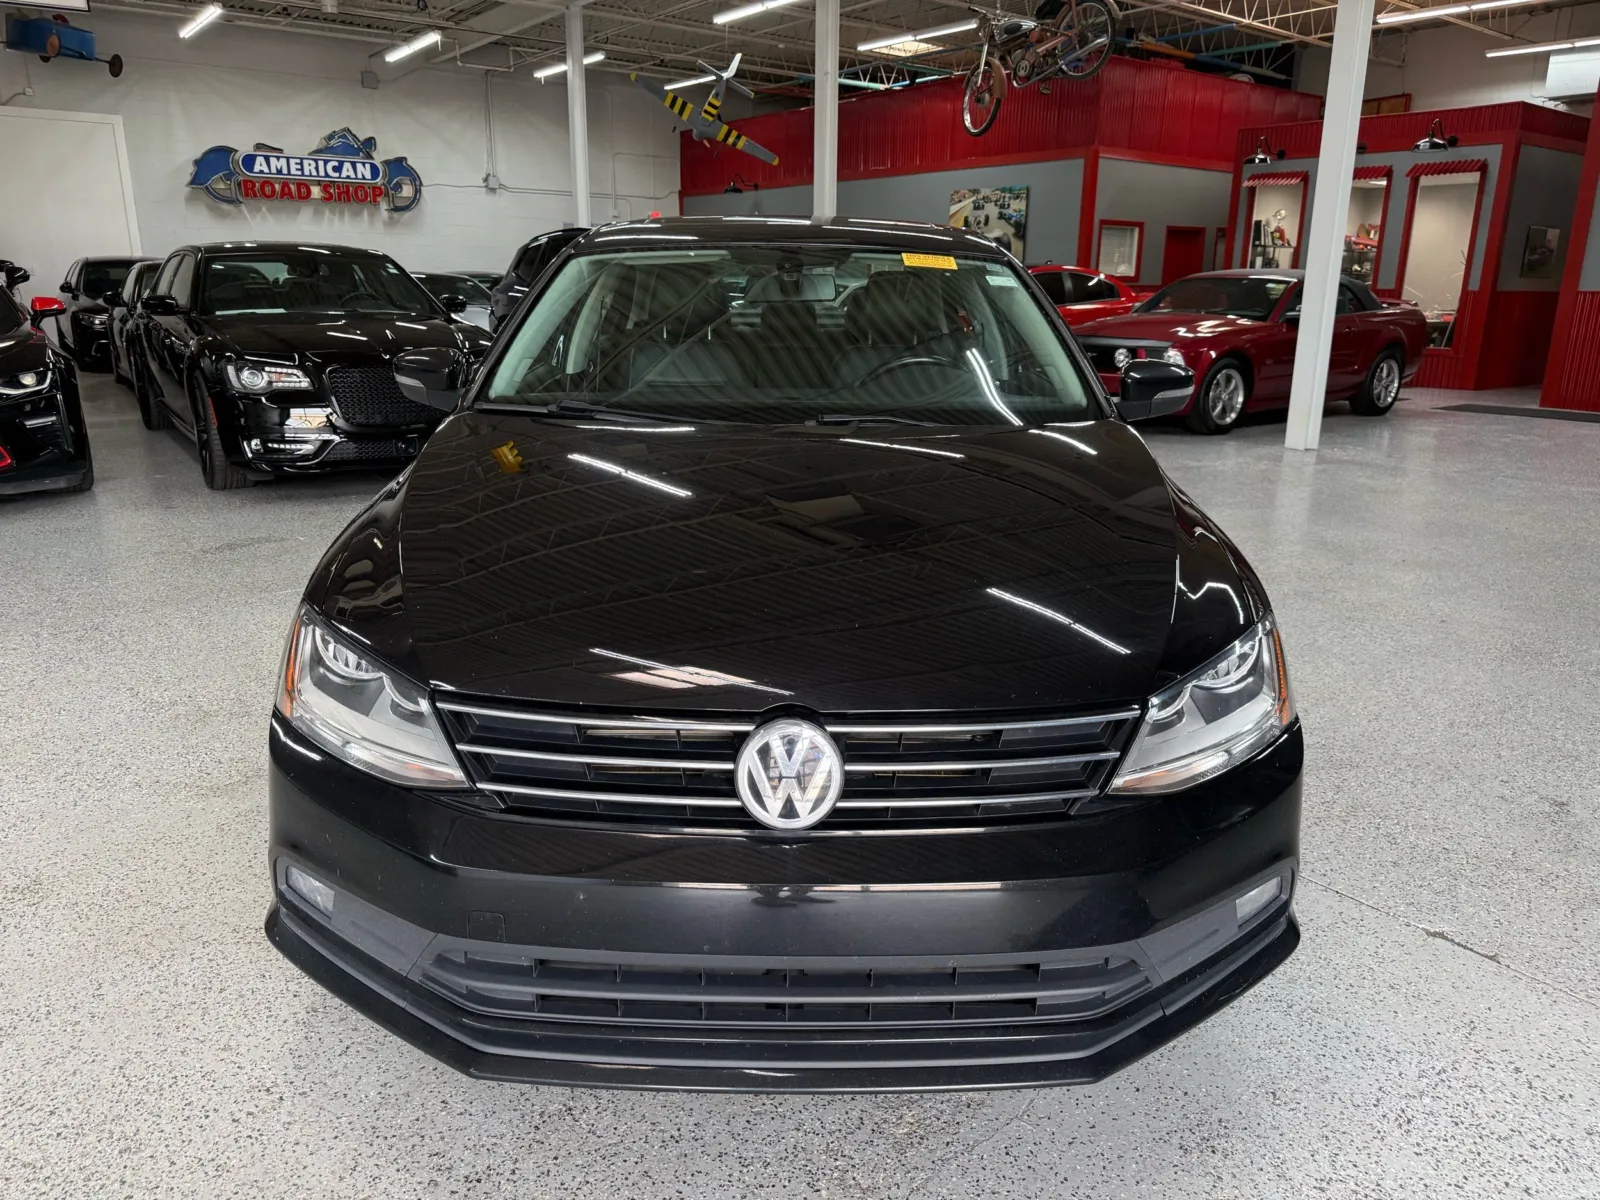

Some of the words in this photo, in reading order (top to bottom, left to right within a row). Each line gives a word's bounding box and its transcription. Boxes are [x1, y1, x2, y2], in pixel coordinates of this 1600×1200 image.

[253, 156, 372, 179] AMERICAN
[241, 179, 312, 201] ROAD
[321, 182, 384, 204] SHOP
[744, 728, 834, 822] VW
